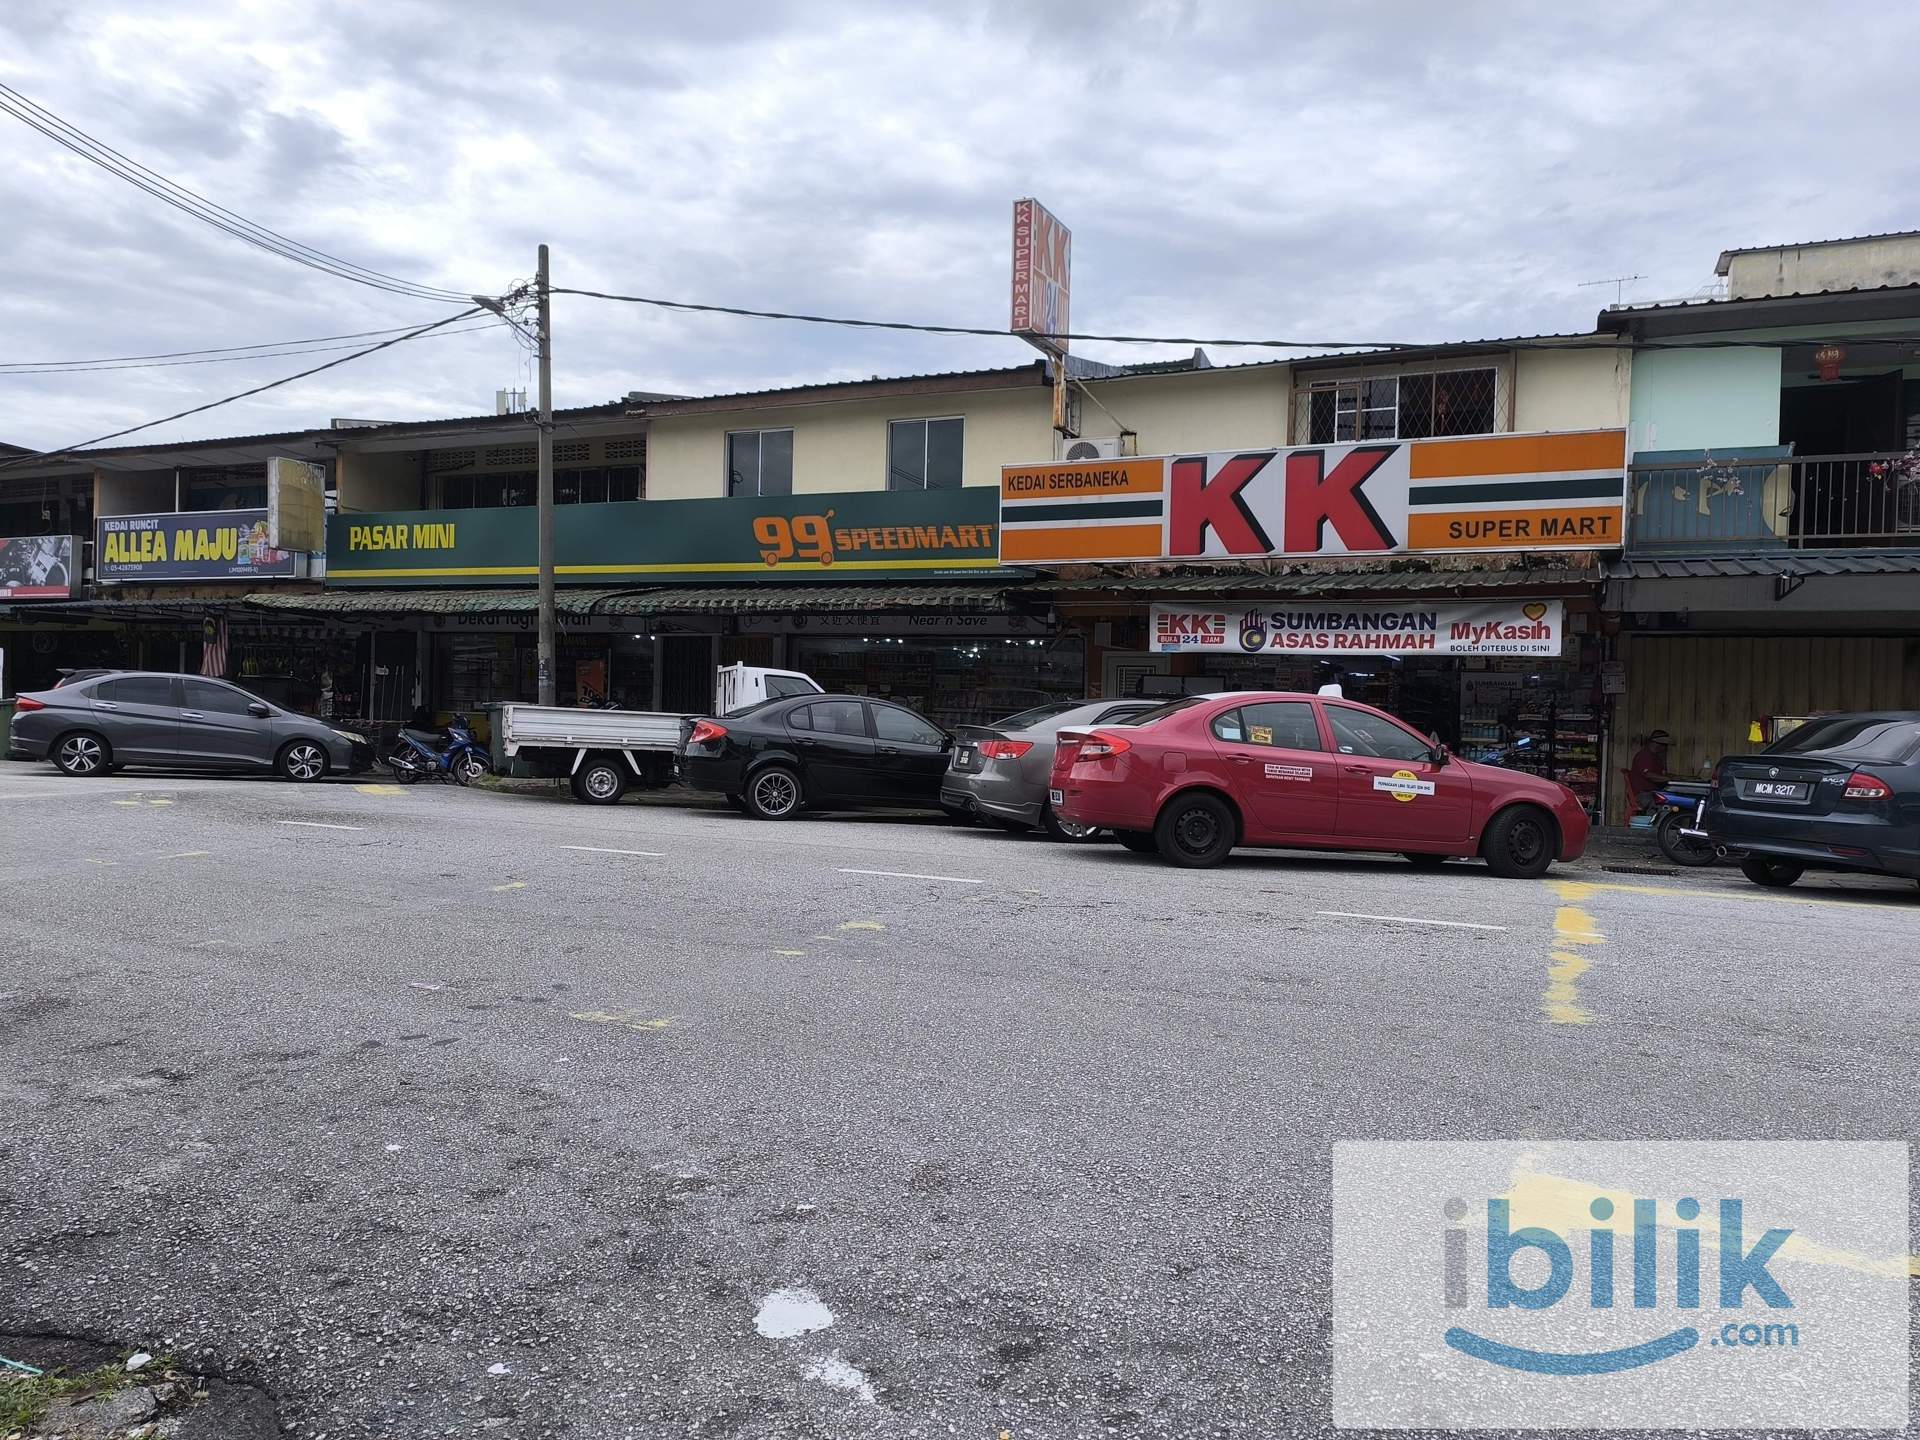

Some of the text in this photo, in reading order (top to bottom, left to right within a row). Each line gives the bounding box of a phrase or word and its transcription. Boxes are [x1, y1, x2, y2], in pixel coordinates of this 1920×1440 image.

[1007, 470, 1129, 492] KEDAI SERBANEKA
[1169, 444, 1403, 557] KK
[104, 519, 159, 531] KEDAI RUNCIT
[1448, 516, 1612, 539] SUPER MART
[104, 527, 238, 563] ALLEA MAJU
[349, 523, 456, 550] PASAR MINI
[753, 509, 994, 567] 99 SPEEDMART
[908, 615, 940, 626] Near
[1169, 614, 1213, 634] KK
[1270, 612, 1437, 630] SUMBANGAN
[1159, 635, 1221, 644] BUKA 24 JAM
[1270, 633, 1436, 649] ASAS RAHMAH
[1450, 620, 1551, 644] MyKasih
[1775, 784, 1796, 796] 3217
